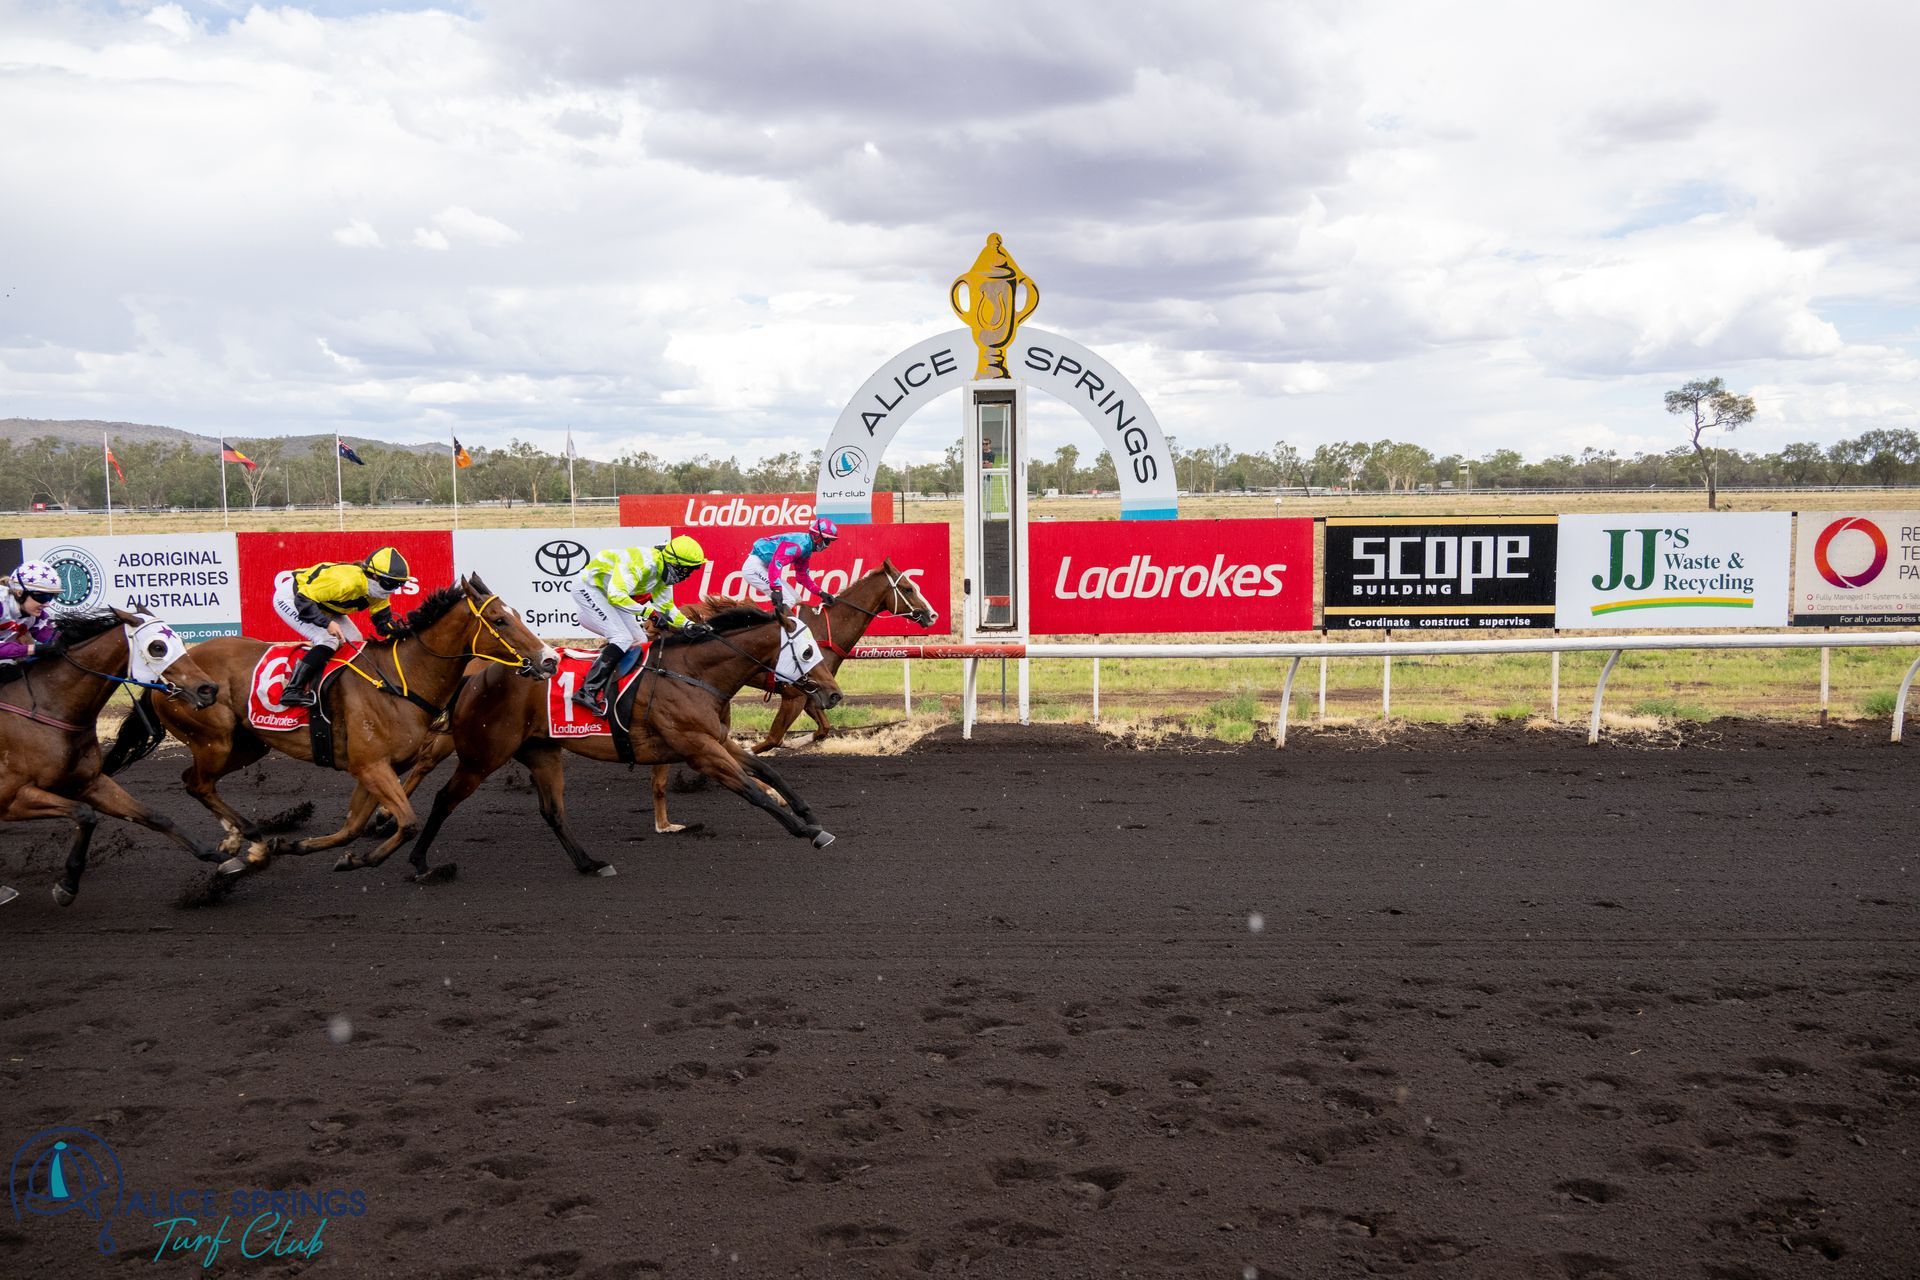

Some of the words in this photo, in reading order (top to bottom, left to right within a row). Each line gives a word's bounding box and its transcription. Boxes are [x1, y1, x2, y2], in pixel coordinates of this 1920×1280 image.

[860, 348, 957, 437] ALICE
[1024, 346, 1157, 484] SPRINGS
[822, 490, 843, 498] turf
[844, 490, 866, 498] club
[118, 551, 222, 567] ABORIGINAL
[1591, 527, 1690, 591] JJ'S
[1664, 553, 1721, 570] Waste
[1727, 551, 1745, 569] &
[71, 552, 100, 595] ENTERPRISES
[114, 571, 229, 588] ENTERPRISES
[1054, 553, 1287, 600] Ladbrokes
[1663, 573, 1754, 595] Recycling
[126, 592, 220, 608] AUSTRALIA
[1348, 617, 1411, 627] Co-ordinate
[1419, 617, 1470, 627] construct
[1479, 617, 1531, 628] supervise
[1840, 615, 1853, 623] For
[1866, 617, 1883, 625] your
[1884, 614, 1916, 622] business
[855, 648, 908, 658] Ladbrokes
[256, 656, 292, 712] 6
[557, 671, 575, 722] 1
[252, 712, 298, 726] Ladbrokes
[553, 723, 602, 734] Ladbrokes
